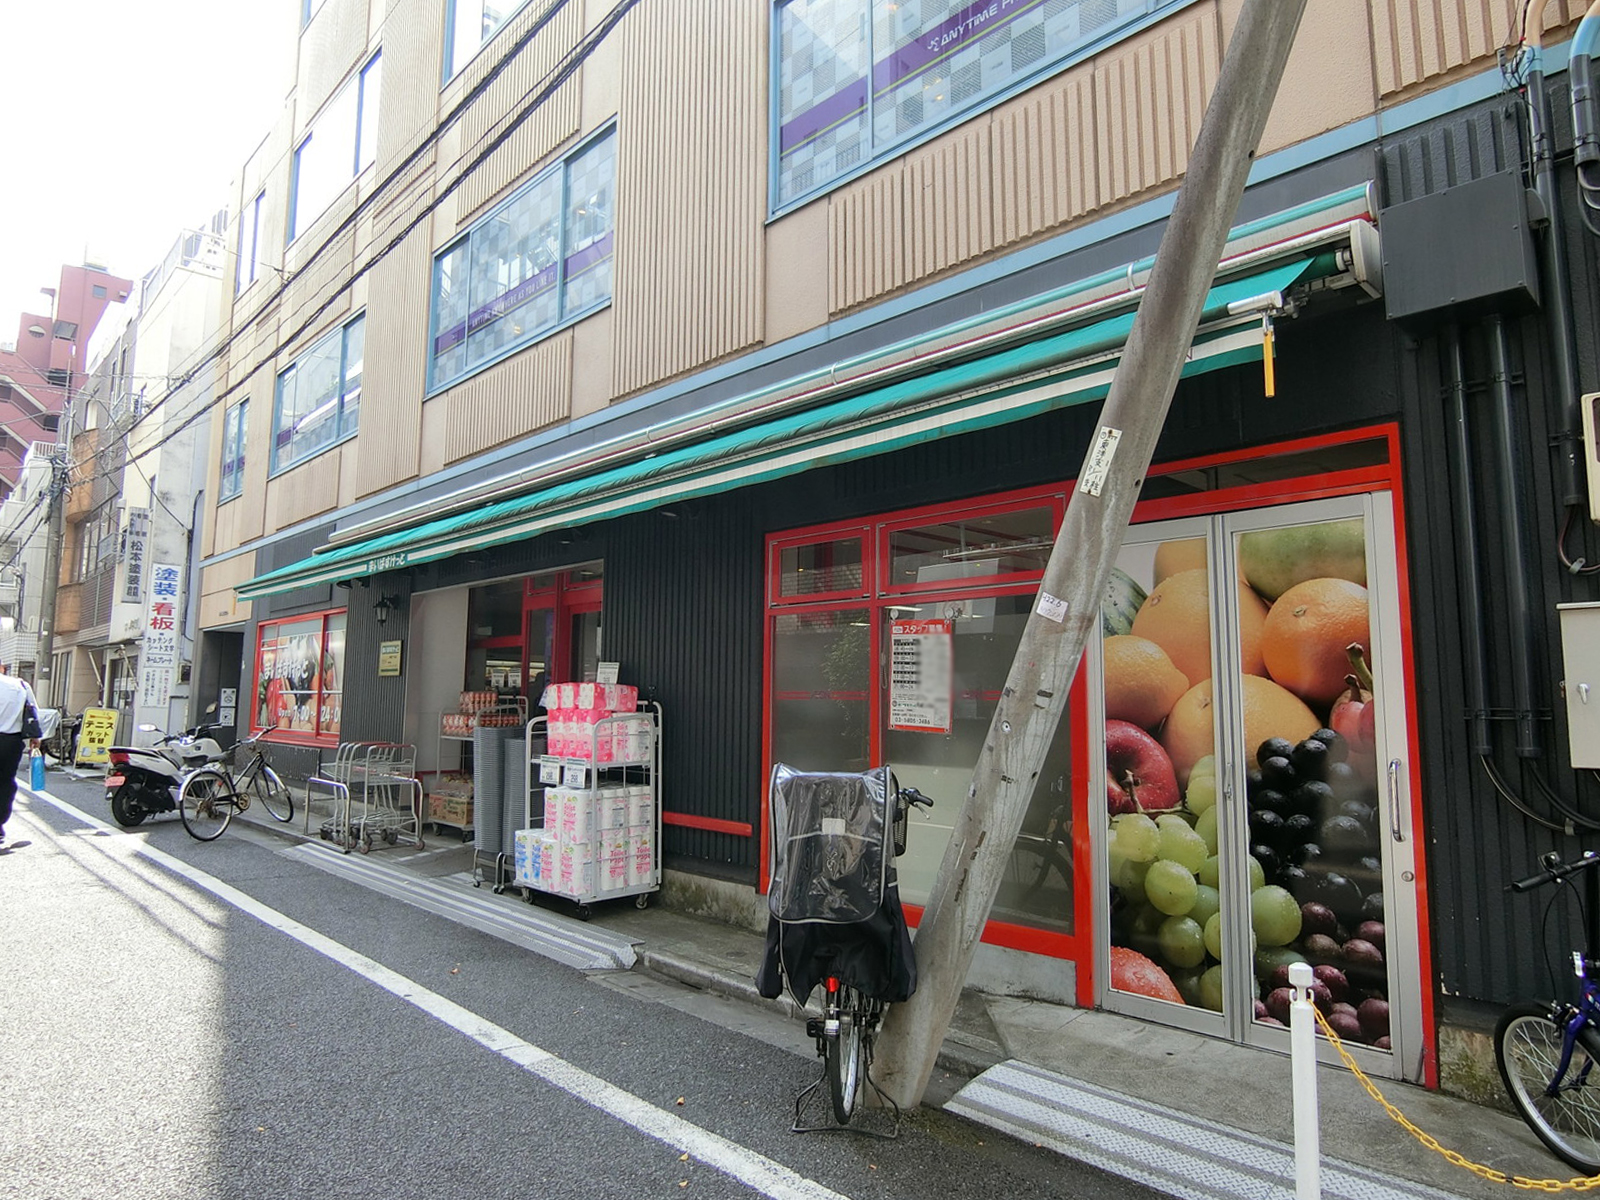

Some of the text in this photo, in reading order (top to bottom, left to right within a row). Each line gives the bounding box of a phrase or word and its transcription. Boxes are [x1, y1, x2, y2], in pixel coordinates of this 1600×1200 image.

[941, 3, 998, 46] ANYTIME
[128, 540, 143, 586] 松本塗装
[368, 553, 406, 573] まいばすけっと
[85, 721, 114, 730] テニス
